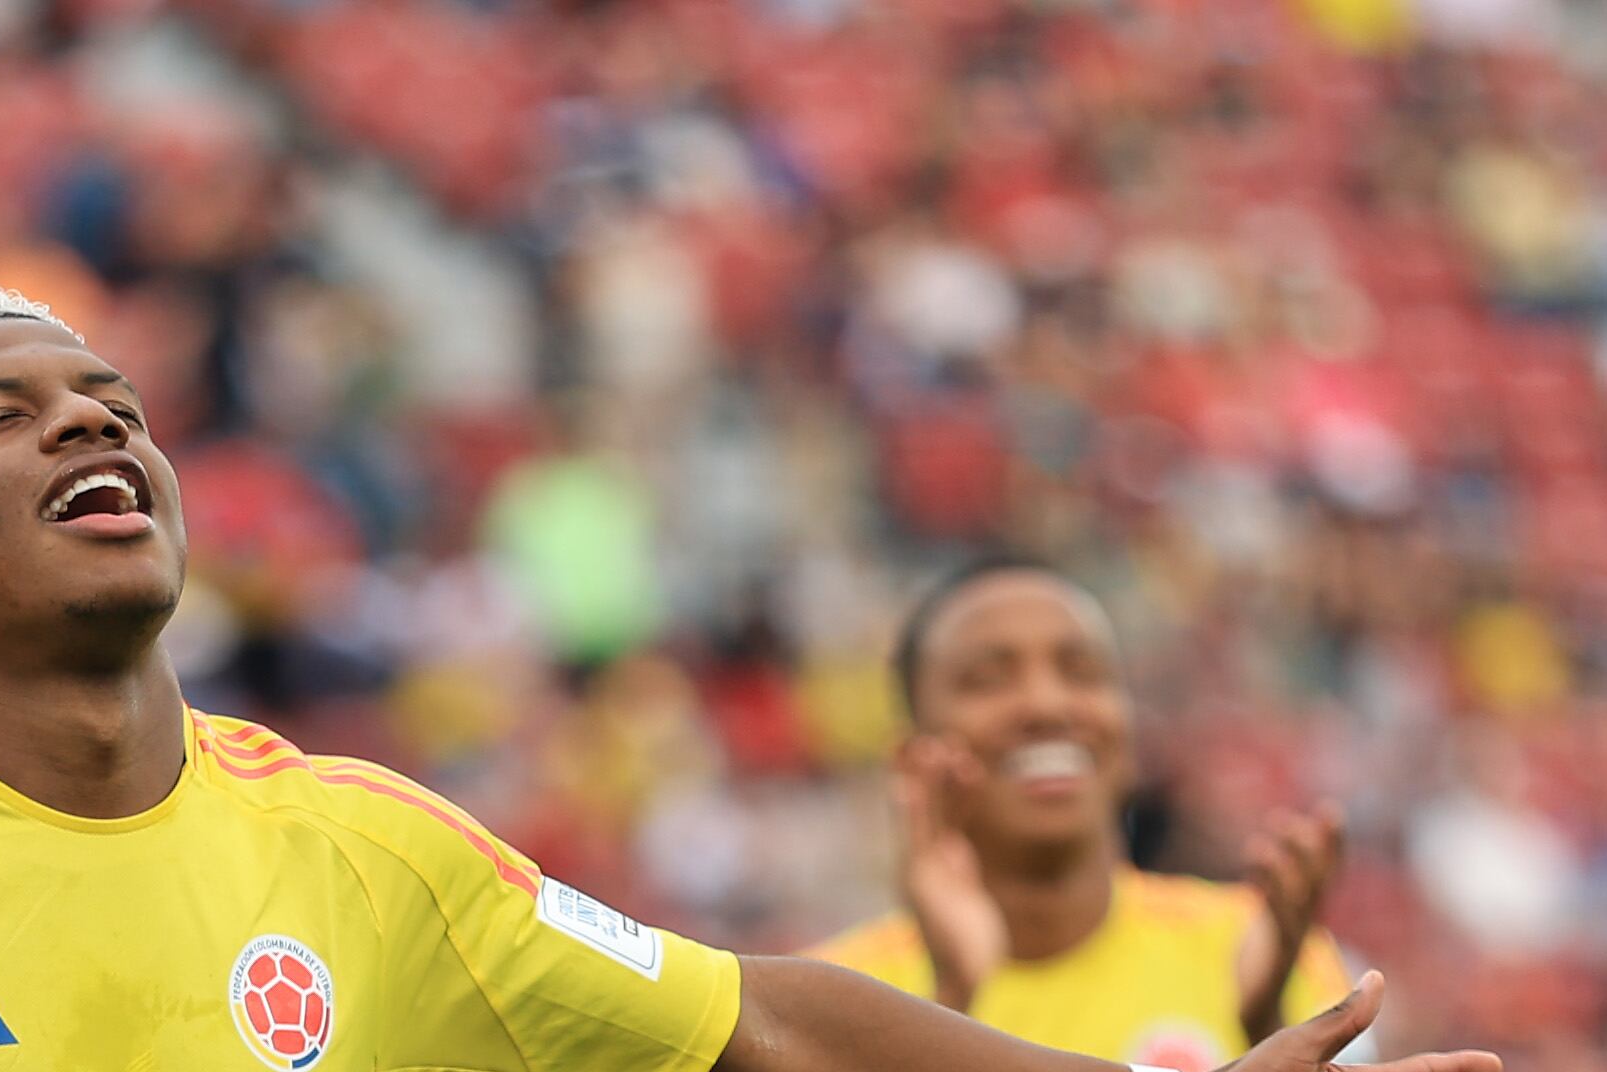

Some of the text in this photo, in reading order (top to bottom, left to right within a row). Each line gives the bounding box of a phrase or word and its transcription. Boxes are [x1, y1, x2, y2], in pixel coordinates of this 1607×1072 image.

[576, 891, 599, 927] UNIT
[253, 939, 304, 959] COLOMBIANA
[304, 953, 315, 967] DE
